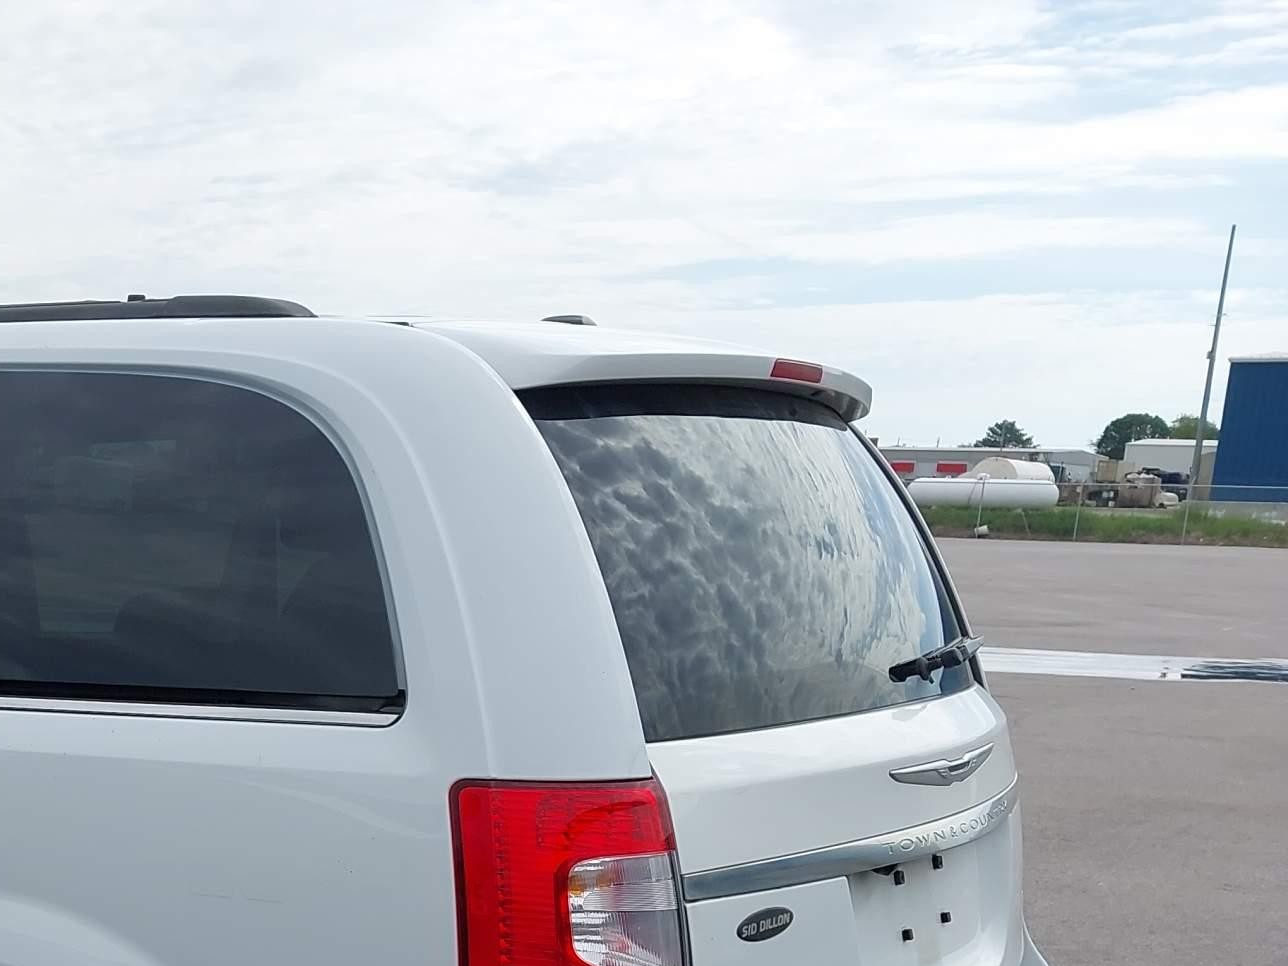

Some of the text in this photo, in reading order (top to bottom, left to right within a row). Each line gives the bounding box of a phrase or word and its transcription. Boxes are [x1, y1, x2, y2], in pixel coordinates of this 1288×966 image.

[881, 829, 946, 856] TOWN
[741, 912, 791, 938] SID DILLON
